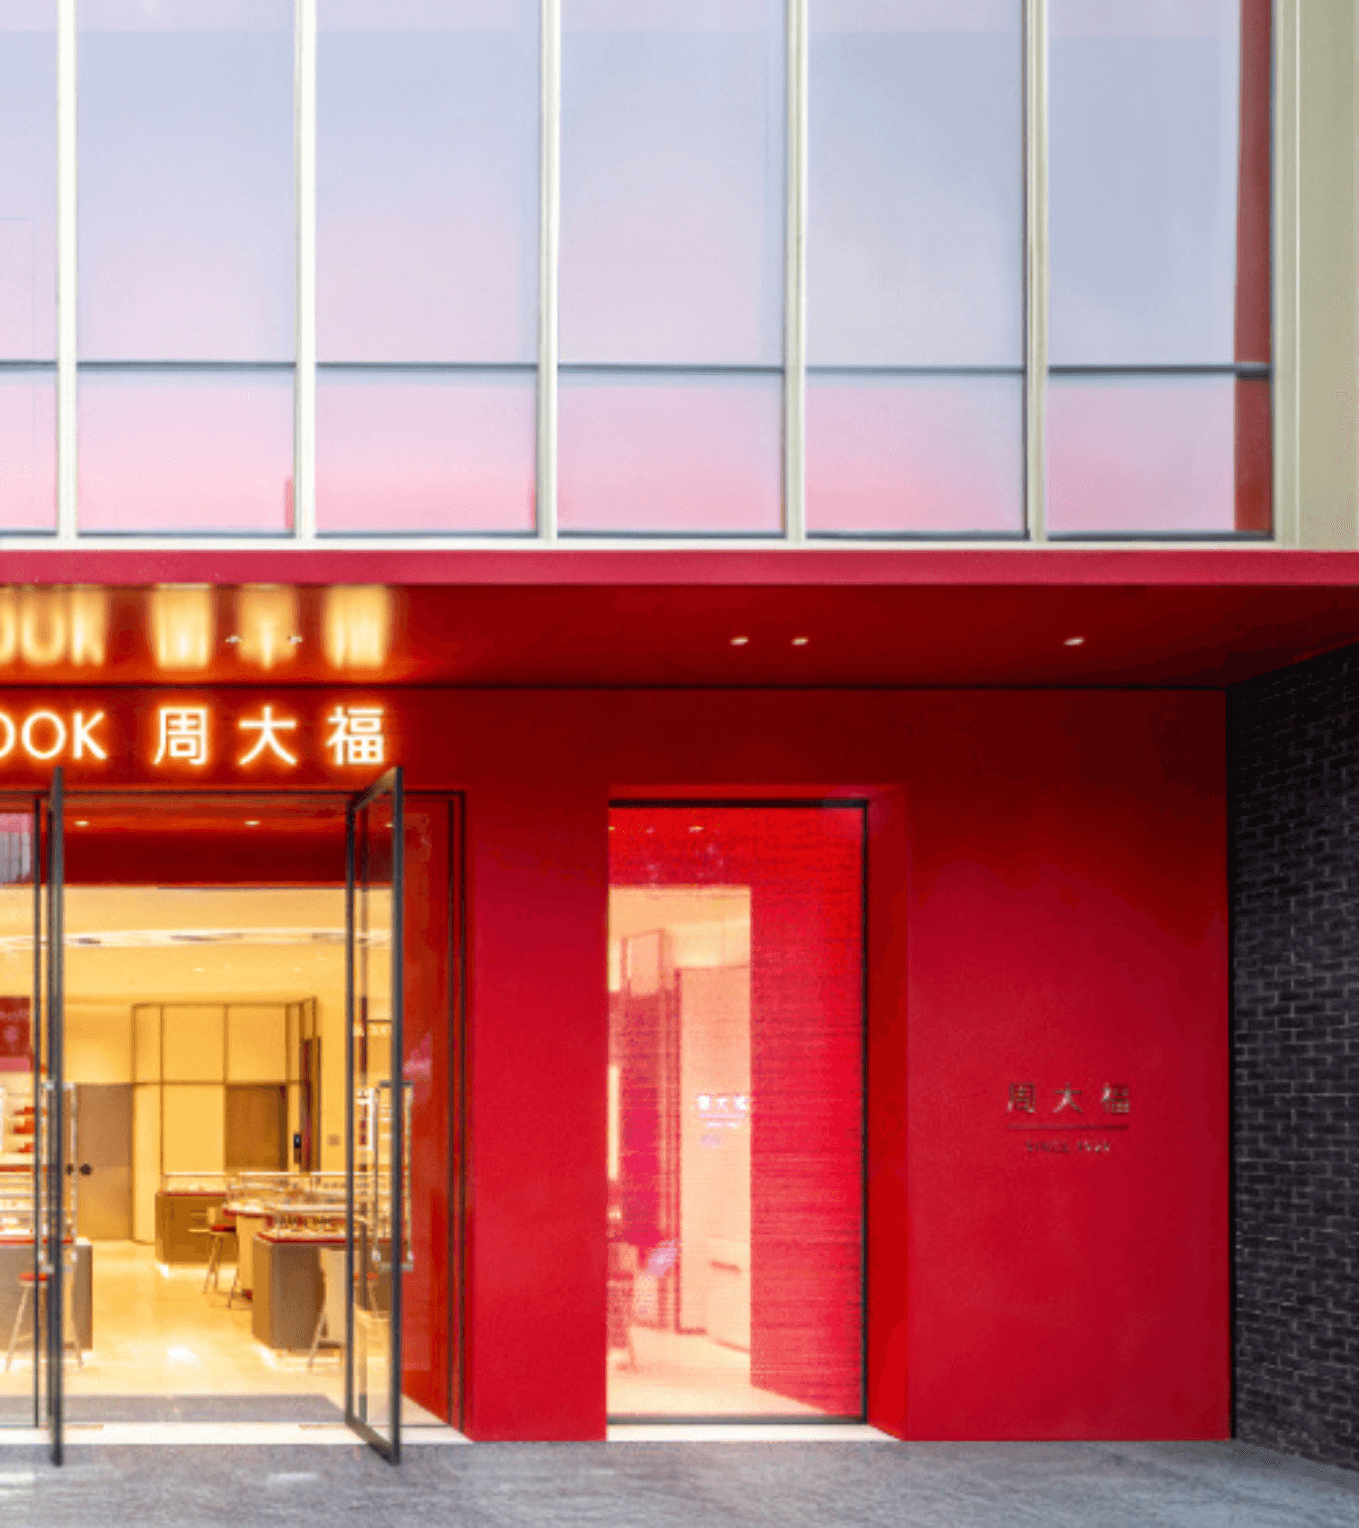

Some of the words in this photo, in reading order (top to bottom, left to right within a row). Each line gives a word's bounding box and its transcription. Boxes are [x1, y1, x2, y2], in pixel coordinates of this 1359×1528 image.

[153, 704, 386, 766] 周大福
[1006, 1082, 1130, 1114] 周大福
